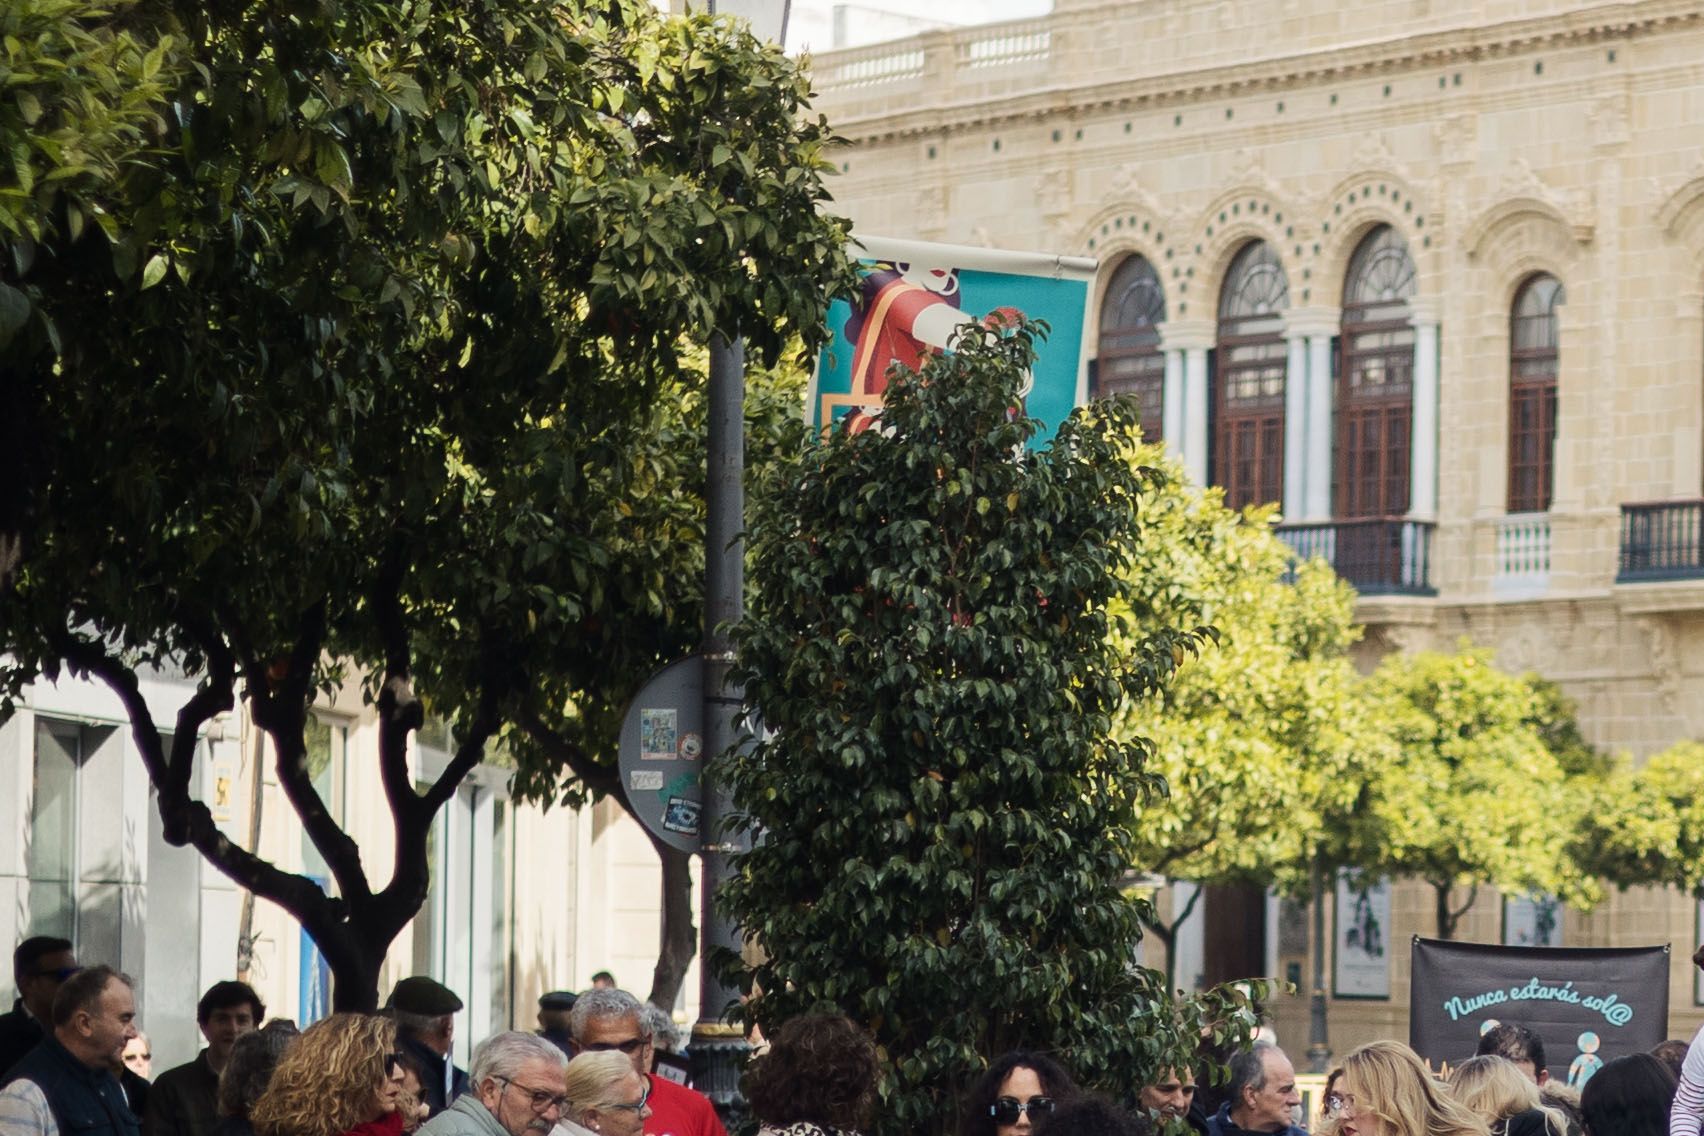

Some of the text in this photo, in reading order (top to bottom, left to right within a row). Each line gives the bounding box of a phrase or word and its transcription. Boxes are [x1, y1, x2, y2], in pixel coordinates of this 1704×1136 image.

[1444, 977, 1634, 1026] Nunca estarás sol@
